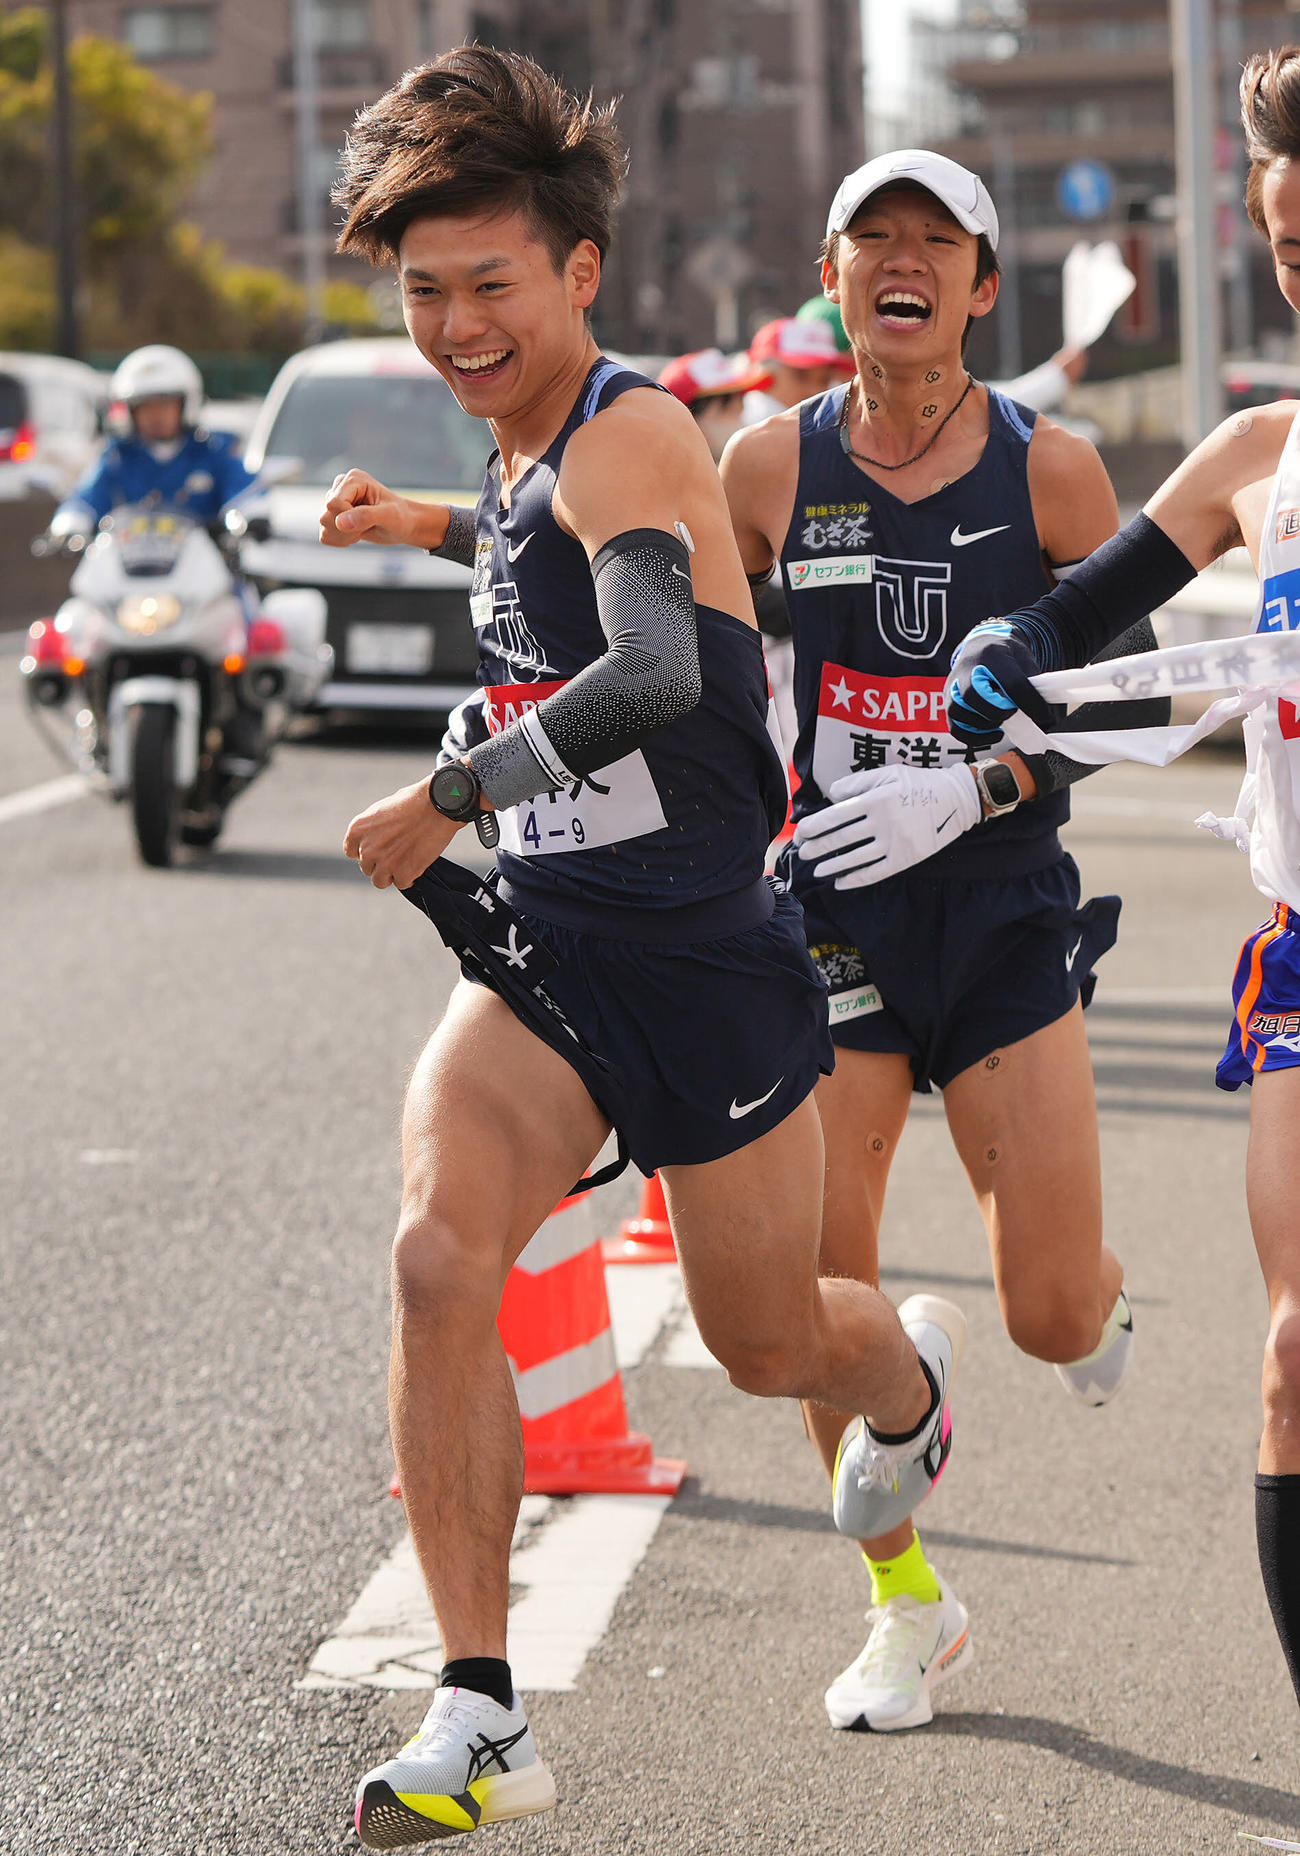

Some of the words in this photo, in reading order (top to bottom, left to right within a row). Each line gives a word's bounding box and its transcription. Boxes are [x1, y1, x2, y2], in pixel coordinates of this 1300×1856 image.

[805, 503, 869, 517] 健康ミネラル
[802, 516, 873, 549] むぎ茶
[815, 563, 867, 579] セブン銀行
